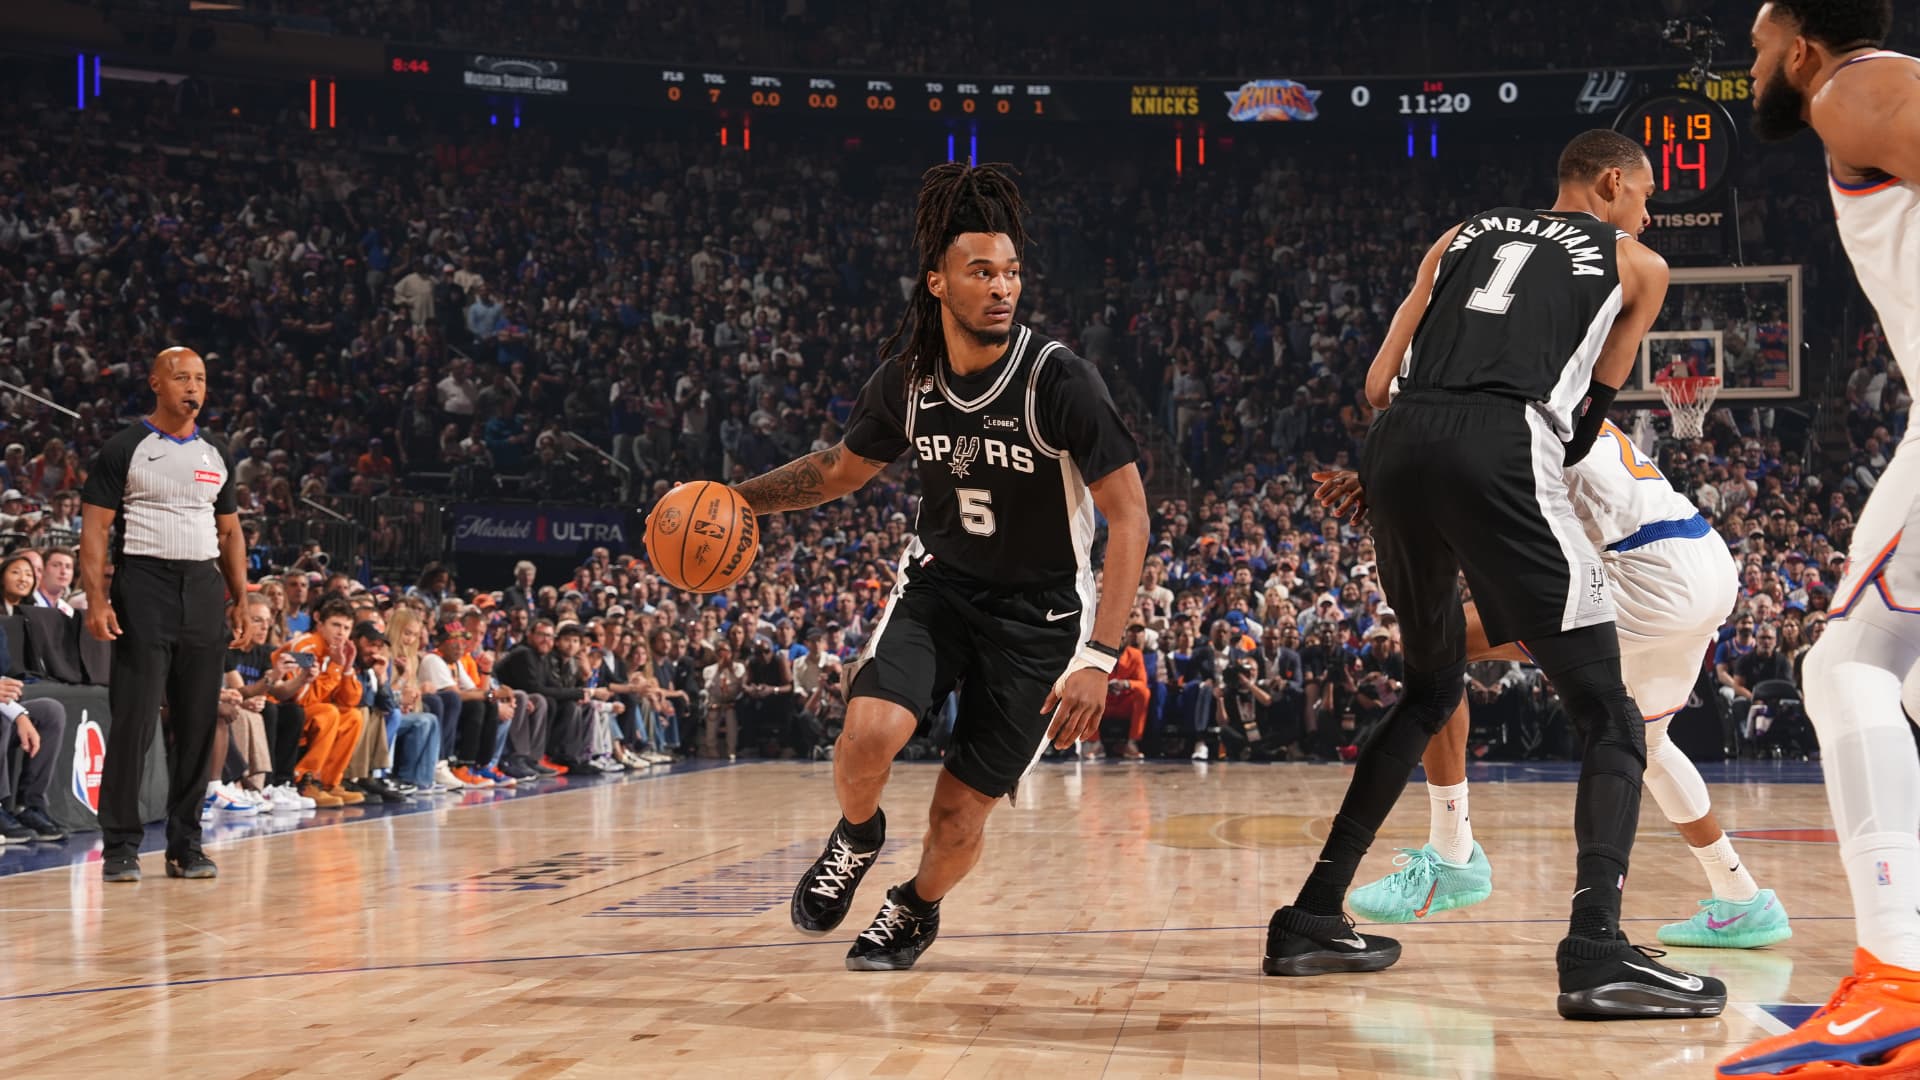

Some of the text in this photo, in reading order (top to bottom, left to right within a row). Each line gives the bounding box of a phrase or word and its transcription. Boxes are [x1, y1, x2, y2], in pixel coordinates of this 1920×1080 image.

[392, 58, 430, 74] 8:44
[535, 76, 567, 91] GARDEN
[702, 73, 726, 84] TOL
[925, 83, 943, 93] TO
[957, 84, 979, 94] STL
[991, 85, 1014, 95] AST
[1131, 86, 1198, 96] NEW YORK
[1498, 81, 1518, 104] 0
[667, 86, 1044, 114] 0 7 0.0 0.0 0.0 0 0 0 1
[1131, 96, 1199, 115] KNICKS
[1233, 84, 1313, 115] KNICKS
[1351, 85, 1370, 107] 0
[1399, 93, 1471, 114] 11:20
[1644, 114, 1712, 141] 11:19
[1662, 143, 1706, 191] 14
[1653, 212, 1723, 228] TISSOT
[1448, 216, 1605, 277] WEMBANYAMA
[1465, 240, 1538, 315] 1
[988, 418, 1015, 428] LEDGER
[955, 487, 996, 537] 5
[552, 521, 624, 542] ULTRA
